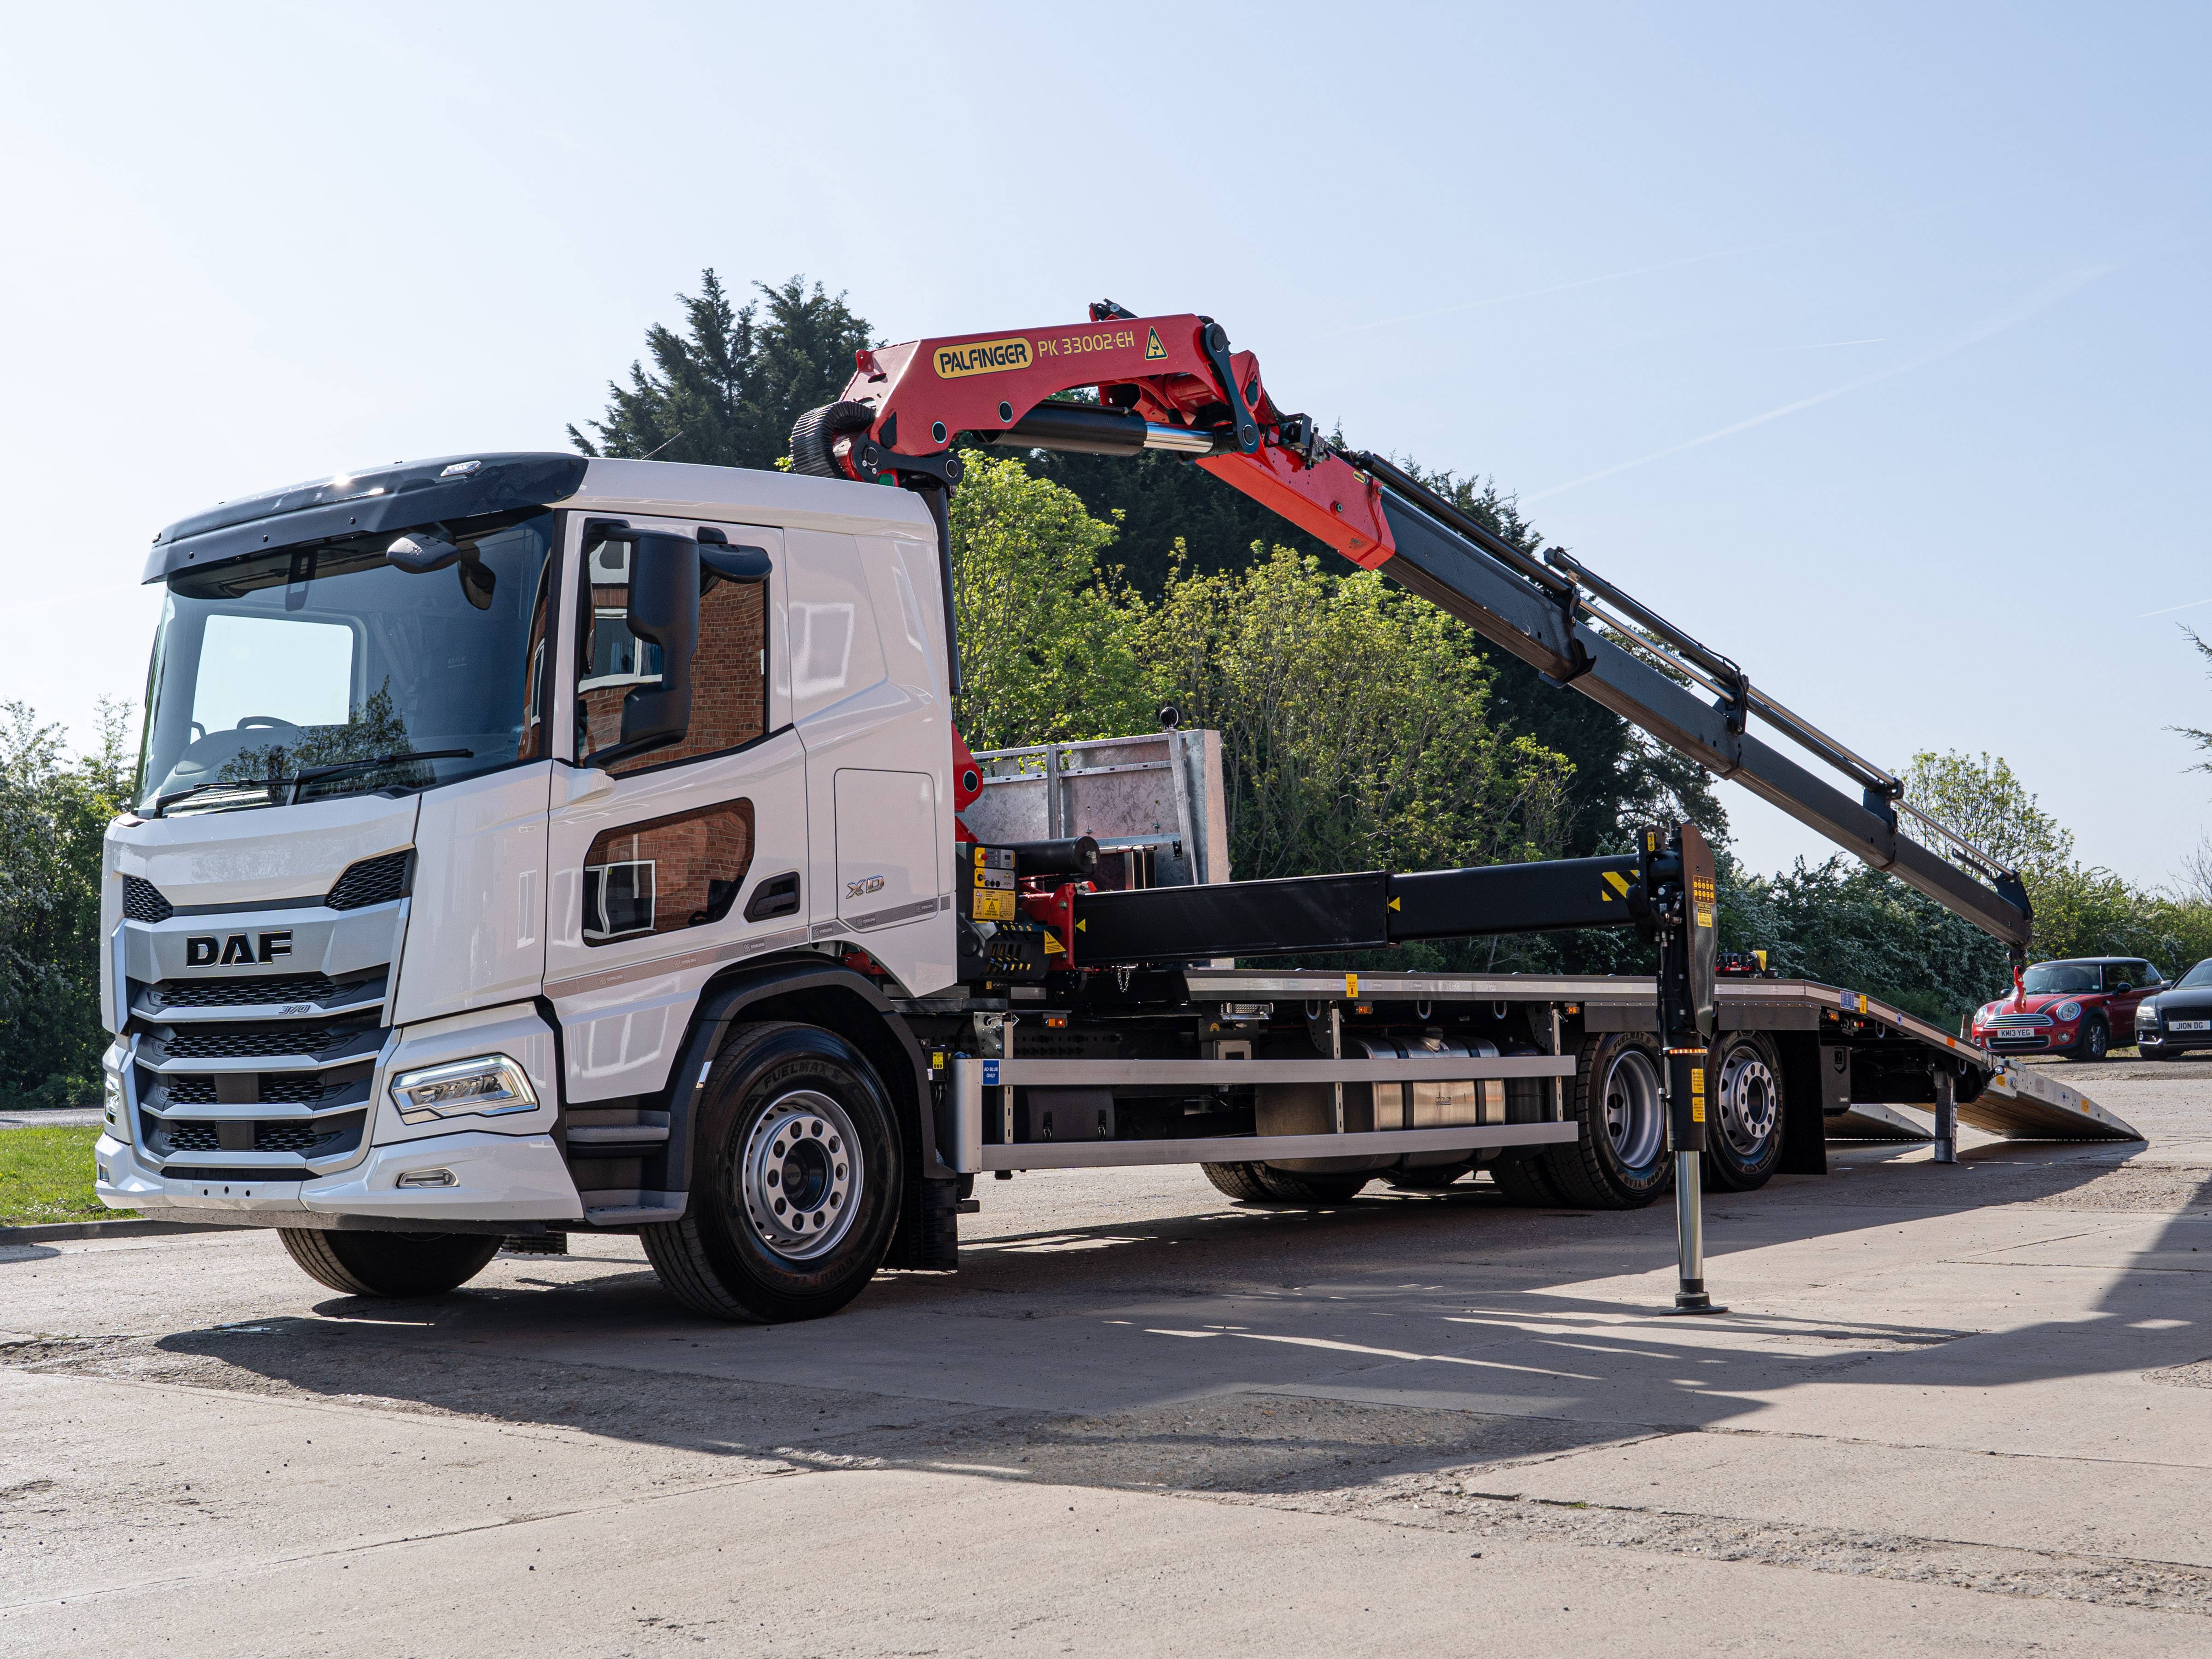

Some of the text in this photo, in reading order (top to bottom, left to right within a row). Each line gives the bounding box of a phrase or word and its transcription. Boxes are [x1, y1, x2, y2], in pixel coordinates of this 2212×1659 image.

[939, 343, 1028, 373] PALFINGER
[1038, 339, 1059, 357] PK
[846, 875, 884, 899] XD
[186, 929, 293, 968] DAF
[279, 1004, 310, 1015] 370
[1614, 1032, 1644, 1052] FUELMAX
[764, 1062, 827, 1089] FUELMAX
